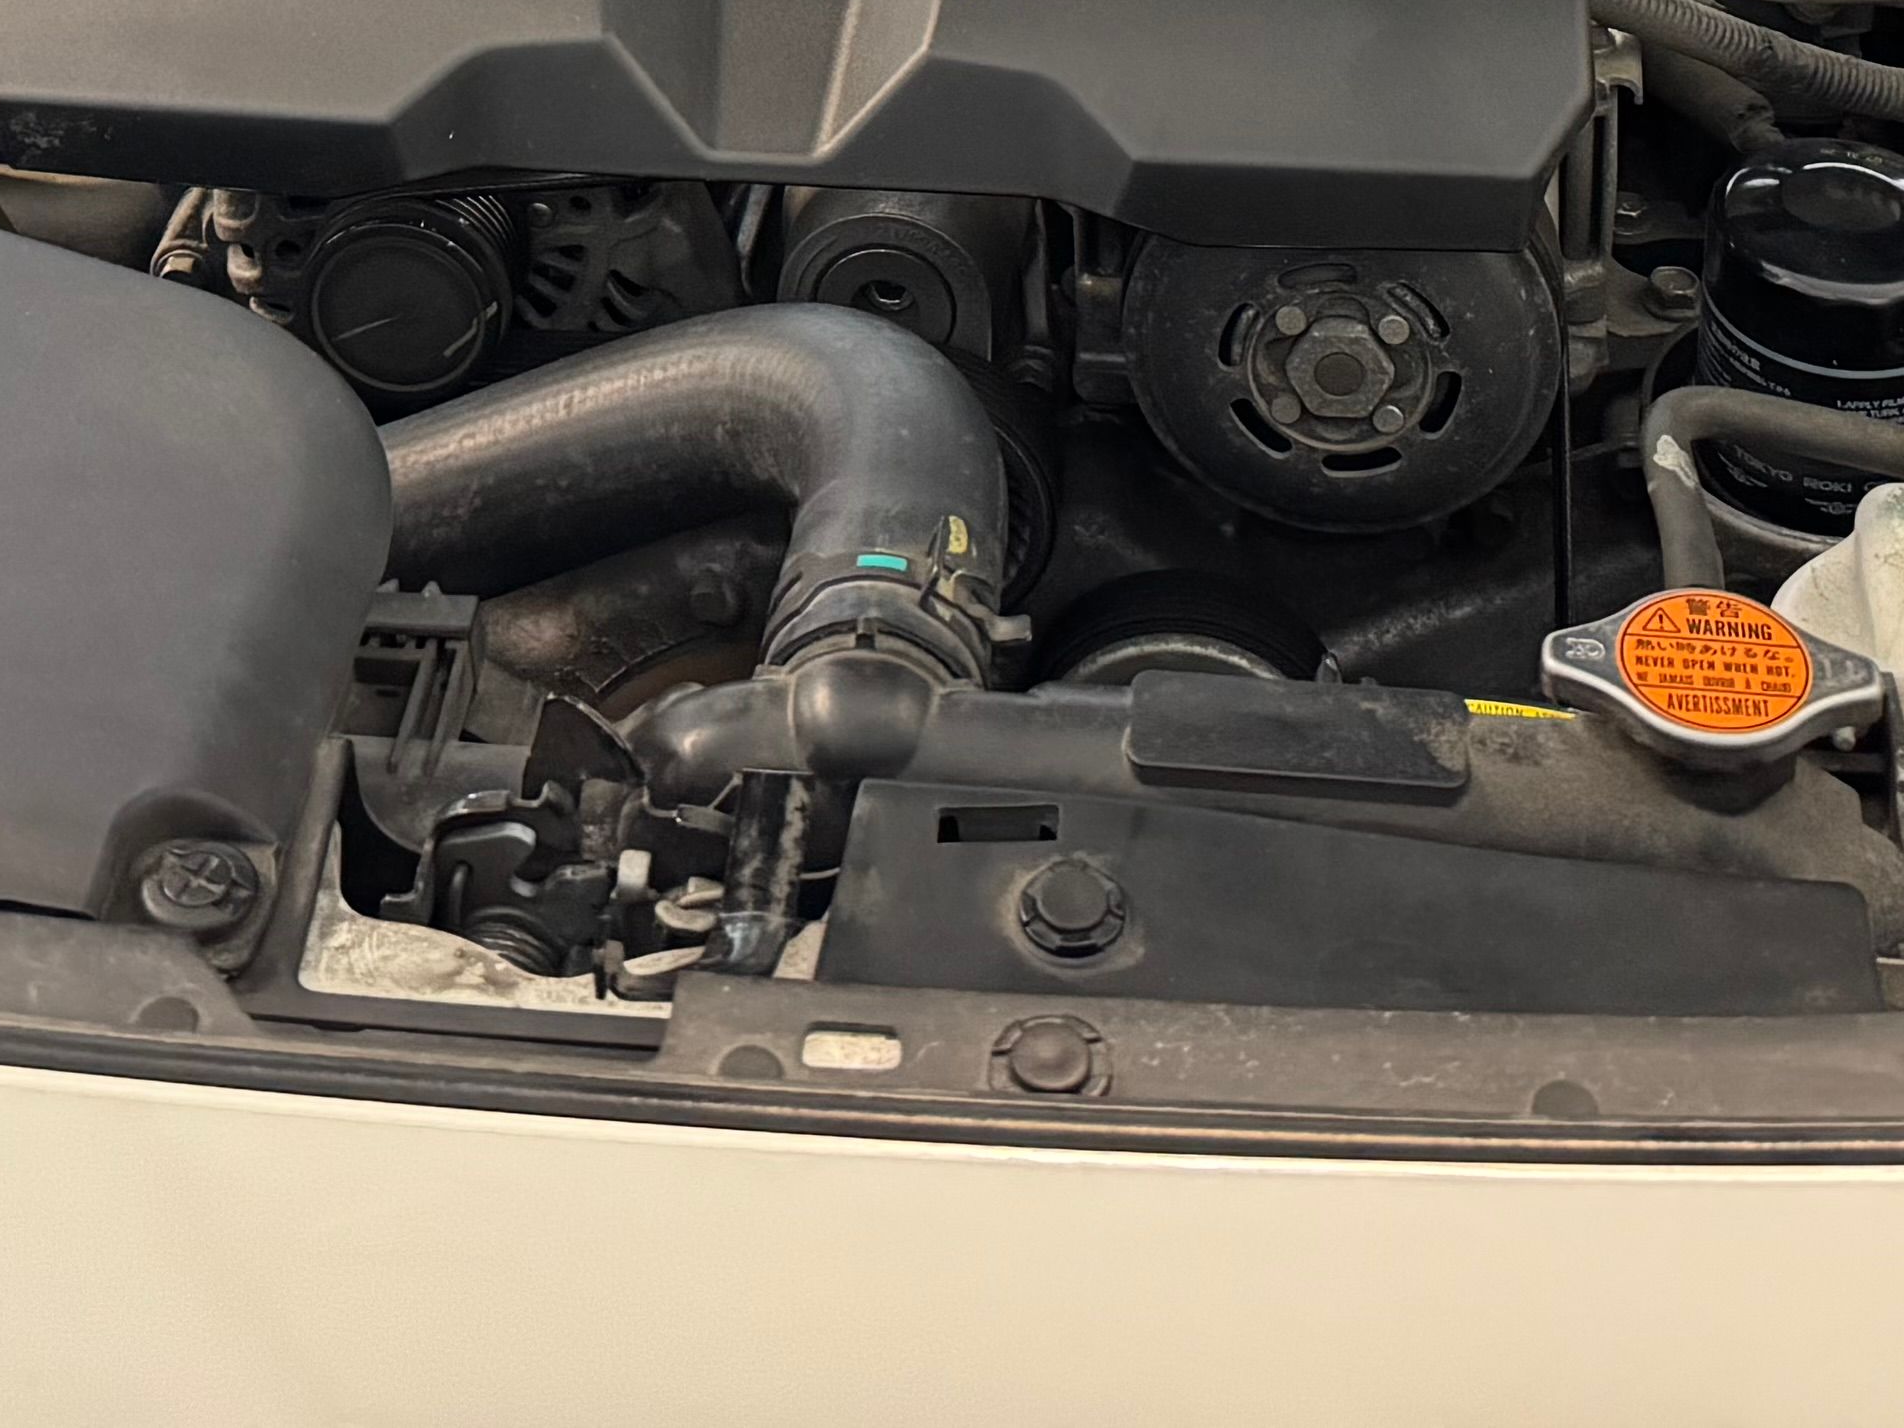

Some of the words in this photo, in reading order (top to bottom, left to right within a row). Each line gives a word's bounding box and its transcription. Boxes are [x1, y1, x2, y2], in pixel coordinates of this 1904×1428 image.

[1685, 598, 1743, 619] 警告
[1686, 618, 1773, 642] WARNING
[1635, 654, 1675, 669] NEVER
[1682, 658, 1716, 672] OPEN
[1667, 692, 1771, 718] AVERTISSMENT
